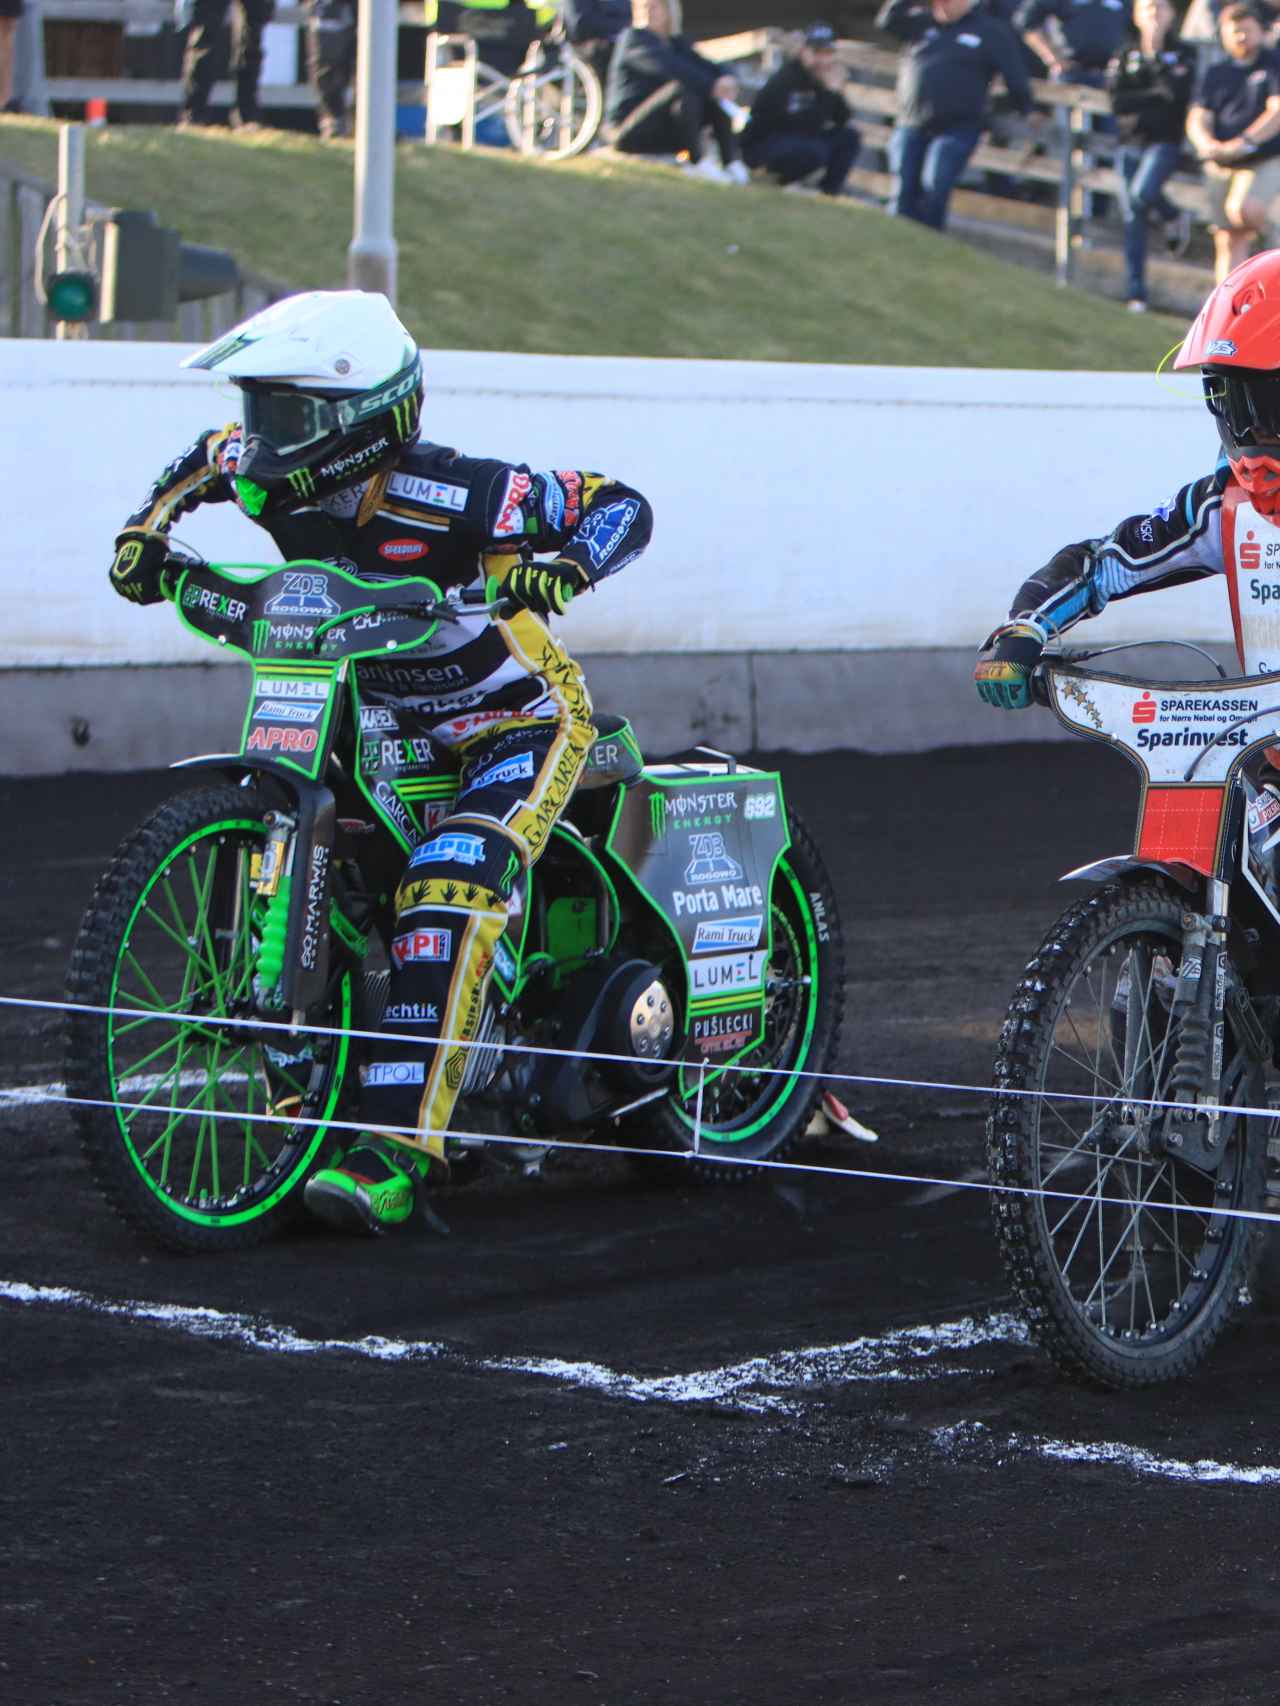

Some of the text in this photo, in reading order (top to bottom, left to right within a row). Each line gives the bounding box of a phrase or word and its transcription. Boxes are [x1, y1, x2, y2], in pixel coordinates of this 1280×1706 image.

[388, 472, 464, 508] LUMEL
[1264, 561, 1275, 570] for
[200, 588, 247, 621] REXER
[270, 623, 346, 642] MONSER
[258, 681, 325, 697] LUMEL
[1161, 699, 1258, 712] SPAREKASSEN
[1160, 714, 1169, 722] for
[1193, 714, 1216, 722] Nebel
[1217, 715, 1228, 724] og
[247, 727, 318, 752] APRO
[382, 738, 435, 766] REXER
[665, 791, 738, 816] MONSTER
[673, 884, 763, 916] Porta Mare
[698, 927, 756, 942] Rami Truck
[694, 961, 759, 988] LUMEL
